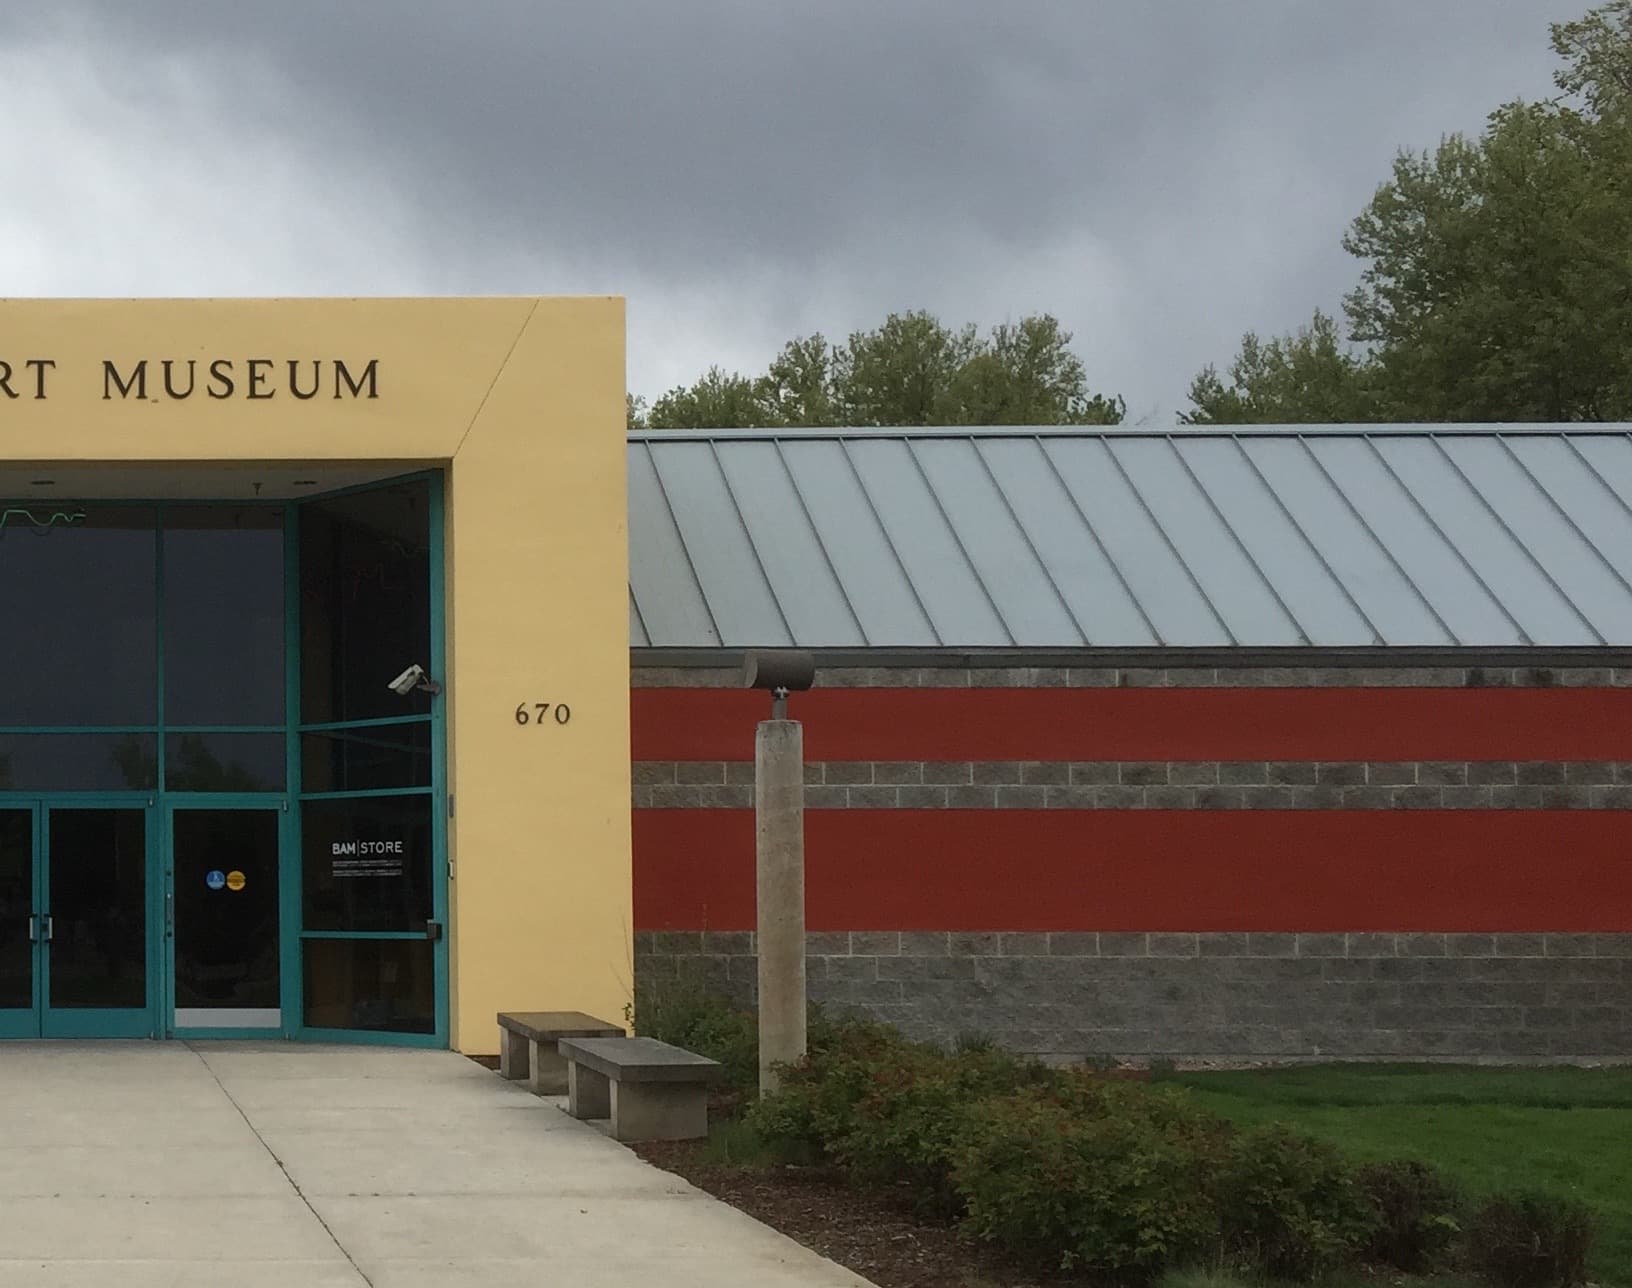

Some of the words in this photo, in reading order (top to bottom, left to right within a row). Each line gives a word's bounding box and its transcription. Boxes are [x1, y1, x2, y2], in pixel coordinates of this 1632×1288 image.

[101, 358, 380, 400] MUSEUM
[515, 702, 571, 725] 670
[332, 842, 356, 855] BAM
[360, 841, 403, 854] STORE
